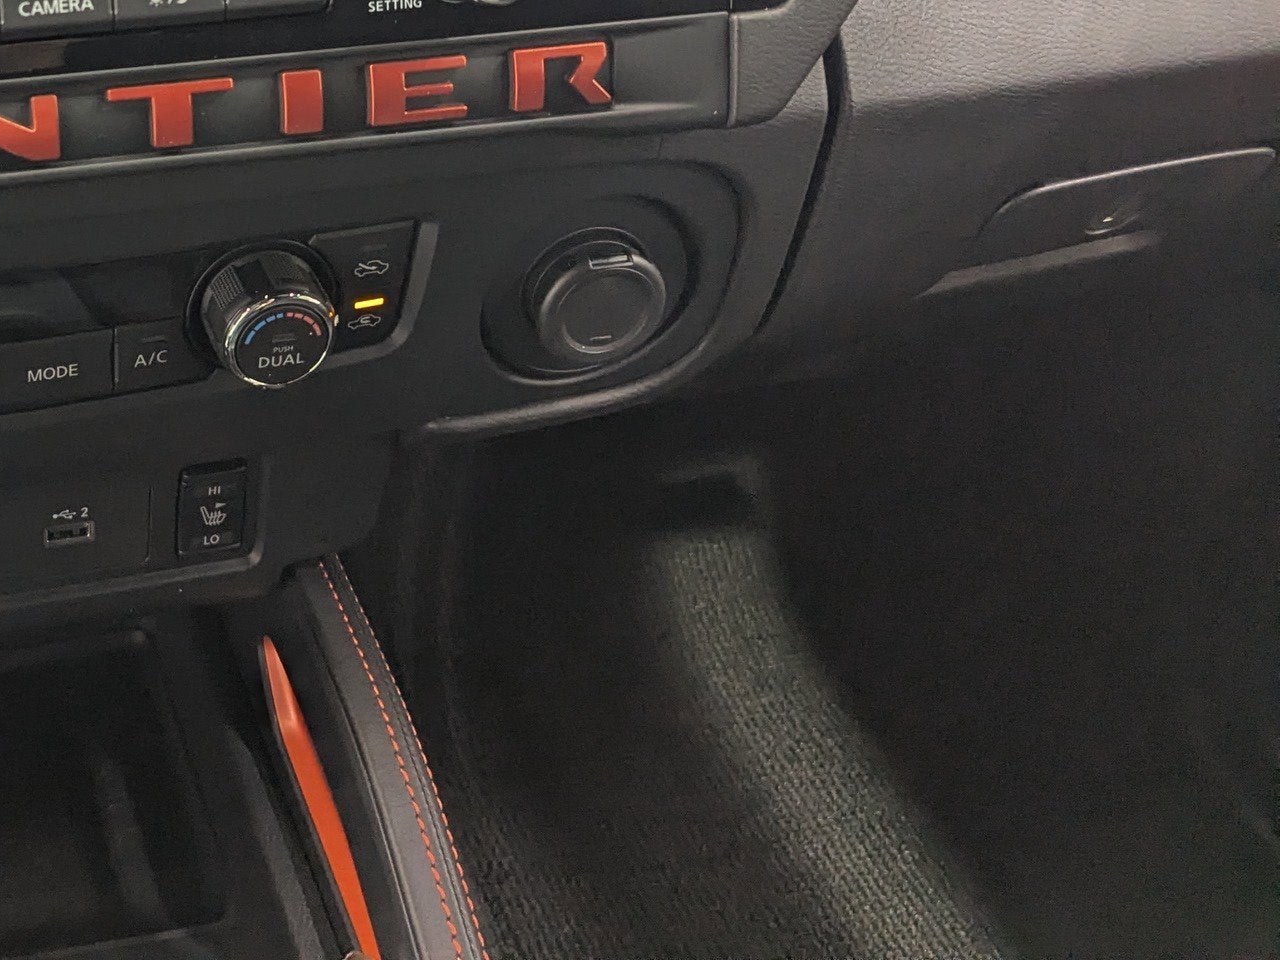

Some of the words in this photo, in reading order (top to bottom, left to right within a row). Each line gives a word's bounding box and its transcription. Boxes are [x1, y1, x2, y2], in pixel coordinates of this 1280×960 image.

[272, 344, 294, 354] PUSH
[134, 350, 168, 368] A/C
[258, 352, 304, 369] DUAL
[27, 364, 79, 382] MODE
[208, 486, 220, 496] HI
[81, 507, 88, 518] 2
[204, 534, 220, 545] LO
